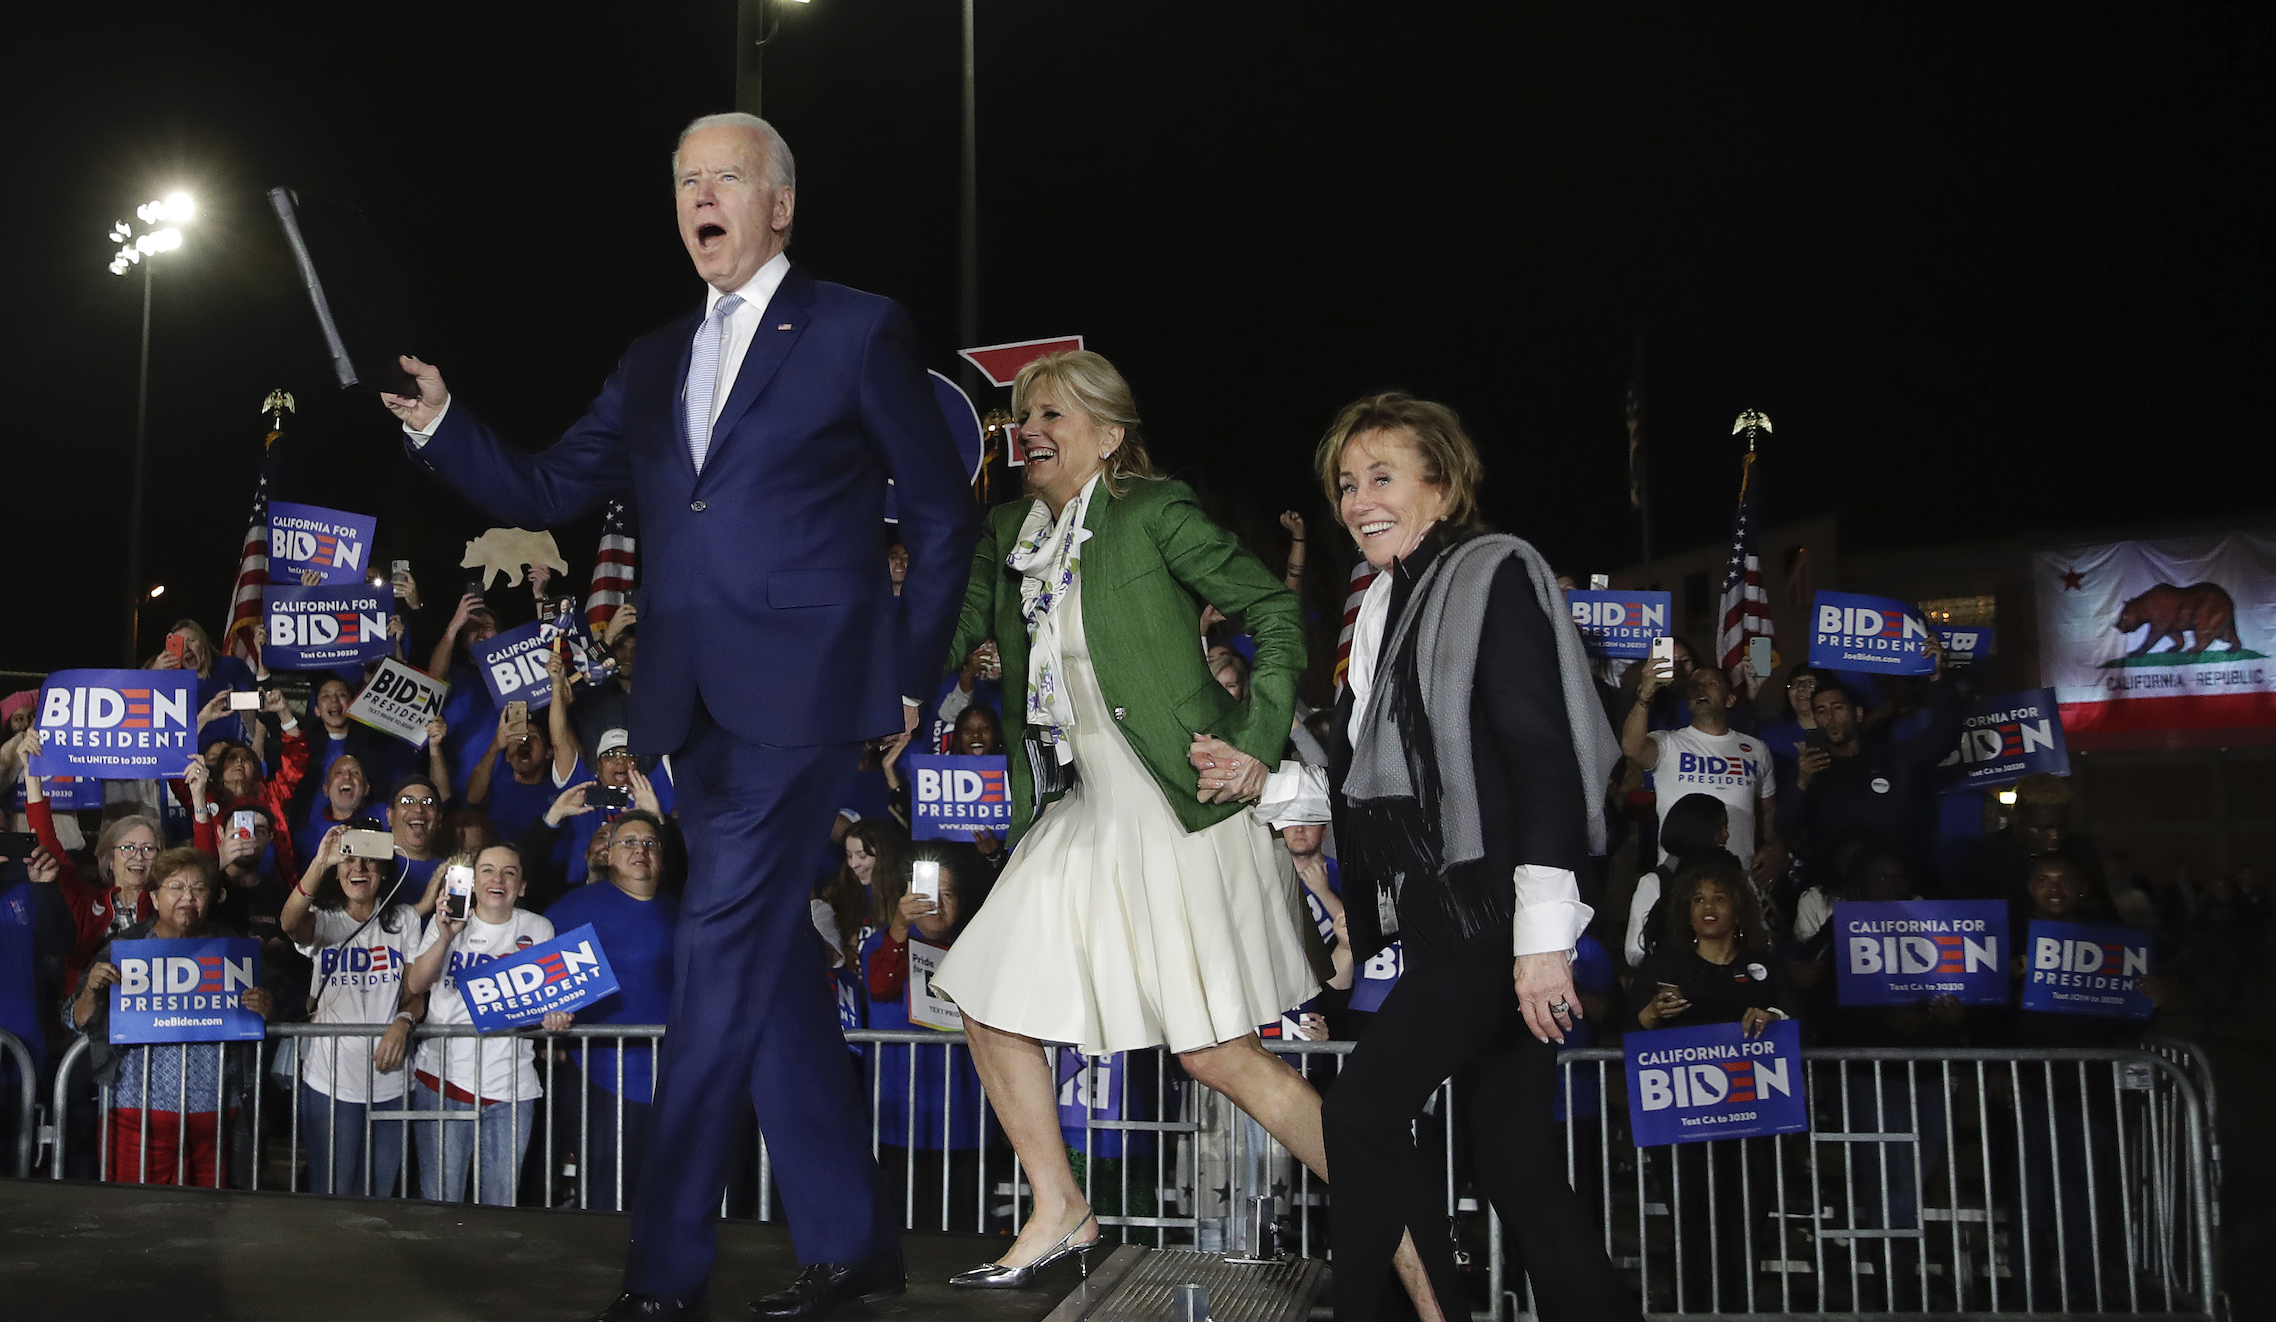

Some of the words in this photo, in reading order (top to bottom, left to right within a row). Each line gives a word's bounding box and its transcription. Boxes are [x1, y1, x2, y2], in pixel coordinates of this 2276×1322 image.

[273, 516, 330, 534] CALIFORNIA
[333, 525, 358, 539] FOR
[272, 528, 363, 571] BIDEN
[272, 600, 350, 612] CALIFORNIA
[352, 599, 378, 610] FOR
[1572, 602, 1664, 627] BIDEN
[271, 611, 388, 646] BIDEN
[1818, 604, 1929, 639] BIDEN
[300, 651, 315, 659] Text
[317, 650, 327, 658] CA
[336, 649, 359, 657] 30330
[486, 636, 547, 664] CALIFORN
[1843, 652, 1901, 664] JoeBiden.com
[2106, 673, 2186, 691] CALIFORNIA
[2196, 669, 2264, 686] REPUBLIC
[371, 668, 443, 717] BIDEN
[531, 687, 546, 698] Text
[41, 687, 188, 729] BIDEN
[2010, 706, 2039, 720] FOR
[38, 729, 187, 748] PRESIDENT
[68, 754, 86, 764] Text
[86, 755, 120, 765] UNITED
[121, 756, 130, 765] to
[131, 756, 158, 765] 30330
[1679, 752, 1758, 776] BIDEN
[1678, 774, 1752, 787] PRESIDEN
[1984, 767, 1994, 775] CA
[918, 803, 1011, 818] PRESIDE
[1849, 919, 1950, 933] CALIFORNIA
[1953, 919, 1985, 932] FOR
[321, 945, 404, 975] BIDEN
[912, 953, 935, 968] Pride
[1850, 936, 1998, 975] BIDEN
[2035, 936, 2148, 977] BIDEN
[120, 956, 254, 996] BIDEN
[467, 940, 599, 1005] BIDEN
[912, 964, 923, 974] for
[322, 973, 401, 987] RESIDEN
[1889, 983, 1908, 991] Text
[1910, 983, 1923, 991] CA
[2033, 971, 2134, 991] PRESIDEN
[477, 966, 600, 1016] PRESIDENT
[120, 995, 239, 1012] PRESIDEN
[505, 1010, 525, 1021] Text
[525, 1004, 549, 1017] JOIN
[559, 988, 586, 1004] 30330
[153, 1016, 223, 1028] JoeBiden.com
[1638, 1045, 1741, 1066] CALIFORNIA
[1742, 1040, 1775, 1057] FOR
[1639, 1057, 1791, 1112] BIDEN
[1681, 1116, 1702, 1126] Text
[1702, 1115, 1716, 1125] CA
[1717, 1114, 1728, 1123] to
[1728, 1111, 1758, 1123] 30330
